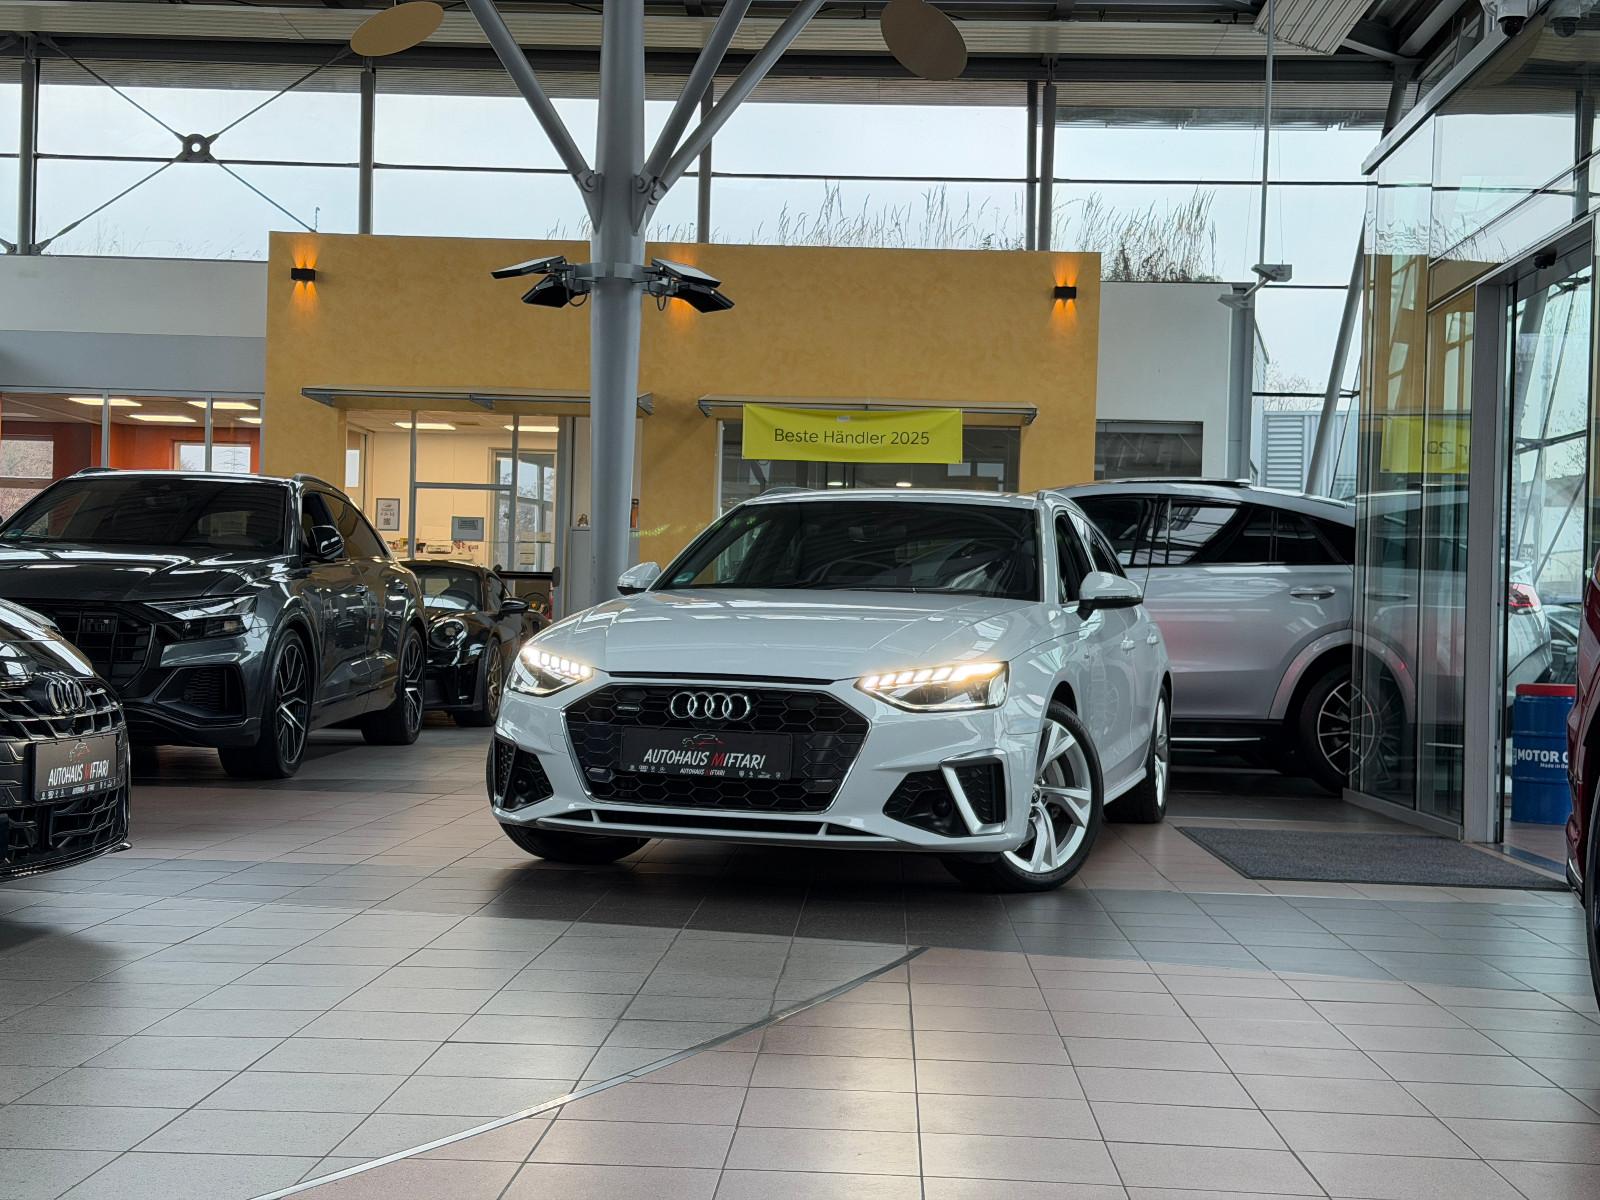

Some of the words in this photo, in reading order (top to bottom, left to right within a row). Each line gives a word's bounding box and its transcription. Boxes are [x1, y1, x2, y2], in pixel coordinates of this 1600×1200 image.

[774, 428, 819, 443] Beste
[824, 430, 886, 445] Händler
[890, 431, 930, 445] 2025
[643, 749, 709, 766] AUTOHAUS
[711, 752, 766, 770] MIFTARI
[1517, 748, 1560, 763] MOTOR
[48, 764, 84, 787] AUTOHAUS
[84, 760, 110, 780] MIFTARI
